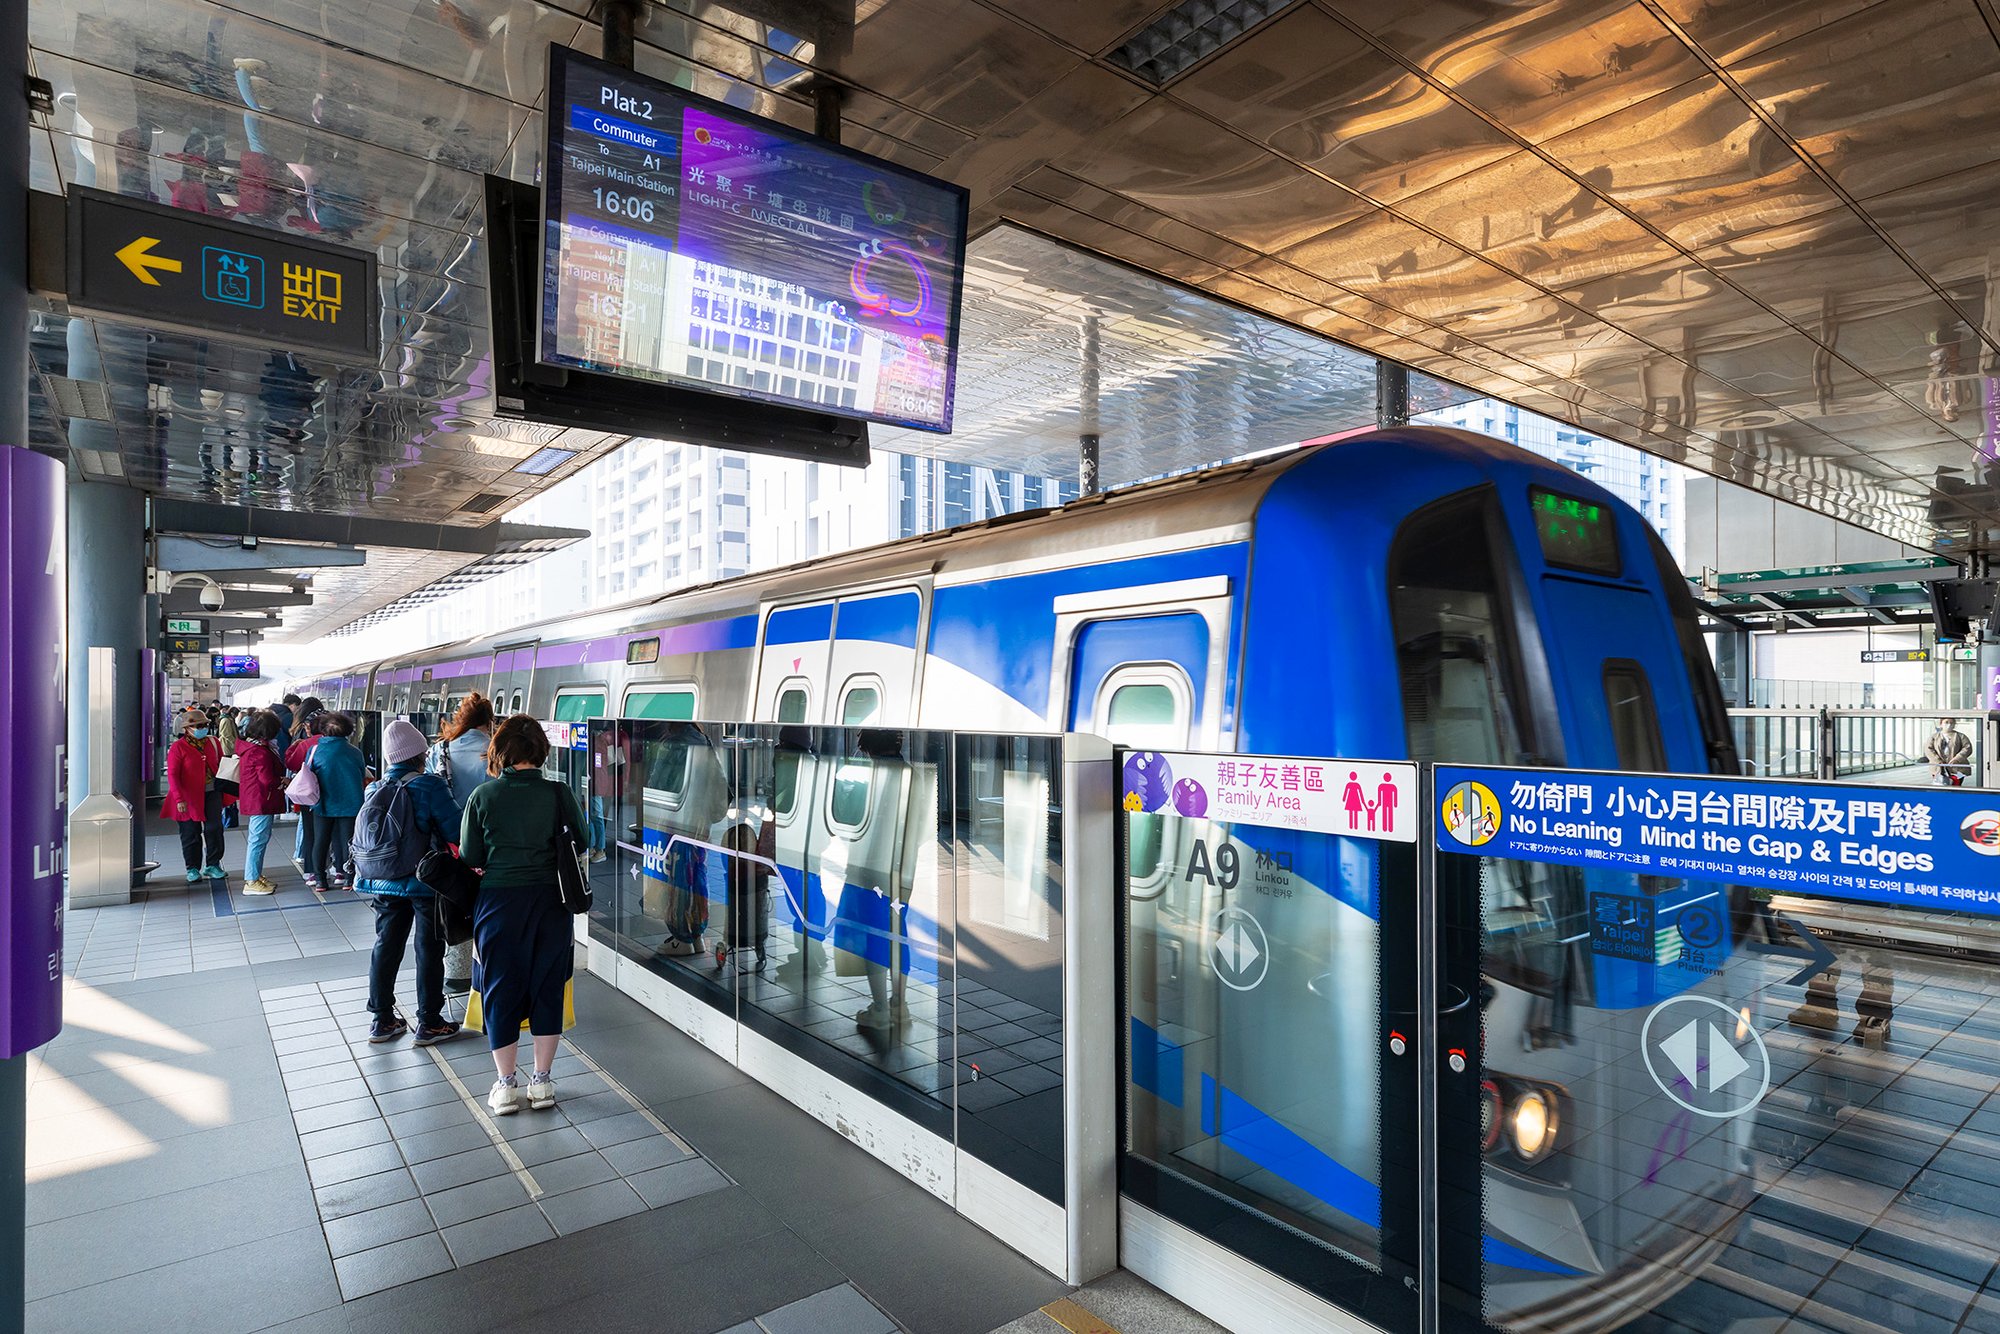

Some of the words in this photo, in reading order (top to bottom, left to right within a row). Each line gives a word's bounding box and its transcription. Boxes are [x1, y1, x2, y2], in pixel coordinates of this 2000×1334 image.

[601, 86, 653, 121] Plat.2
[593, 118, 657, 148] Commuter
[598, 143, 610, 156] To
[643, 154, 660, 171] A1
[570, 155, 605, 175] Taipei
[607, 166, 634, 185] Main
[637, 175, 675, 197] Station
[592, 187, 655, 222] 16:06
[689, 190, 728, 209] LIGHT
[797, 223, 818, 237] ALL
[283, 262, 342, 306] 出口
[568, 264, 601, 281] Taipei
[283, 298, 341, 324] EXIT
[899, 396, 935, 415] 16:06
[1217, 761, 1325, 792] 親子友善區
[1217, 788, 1261, 810] Family
[1266, 792, 1301, 811] Area
[1510, 780, 1593, 815] 勿倚門
[1606, 785, 1933, 841] 小心月台間隙及門縫
[1509, 841, 1582, 856] ドアに寄りかからない
[1584, 848, 1651, 865] 隙間とドアに注意
[1510, 815, 1537, 834] No
[1542, 817, 1622, 847] Leaning
[1641, 825, 1696, 850] Mind
[1702, 831, 1741, 854] the
[1748, 834, 1802, 864] Gap
[1810, 840, 1832, 862] &
[1840, 841, 1934, 874] Edges
[1185, 839, 1240, 890] A9
[1255, 847, 1293, 873] 林口
[1255, 871, 1289, 886] Linkou
[1659, 856, 1677, 867] 문에
[1679, 858, 1705, 871] 기대지
[1706, 861, 1733, 873] 마시고
[1737, 865, 1766, 878] 열차와
[1768, 868, 1797, 881] 승강장
[1800, 871, 1830, 885] 사이의
[1832, 875, 1853, 887] 간격
[1869, 879, 1901, 893] 도어의
[1600, 923, 1645, 943] Taipei
[1678, 947, 1705, 964] 月台
[1677, 961, 1725, 977] Platform
